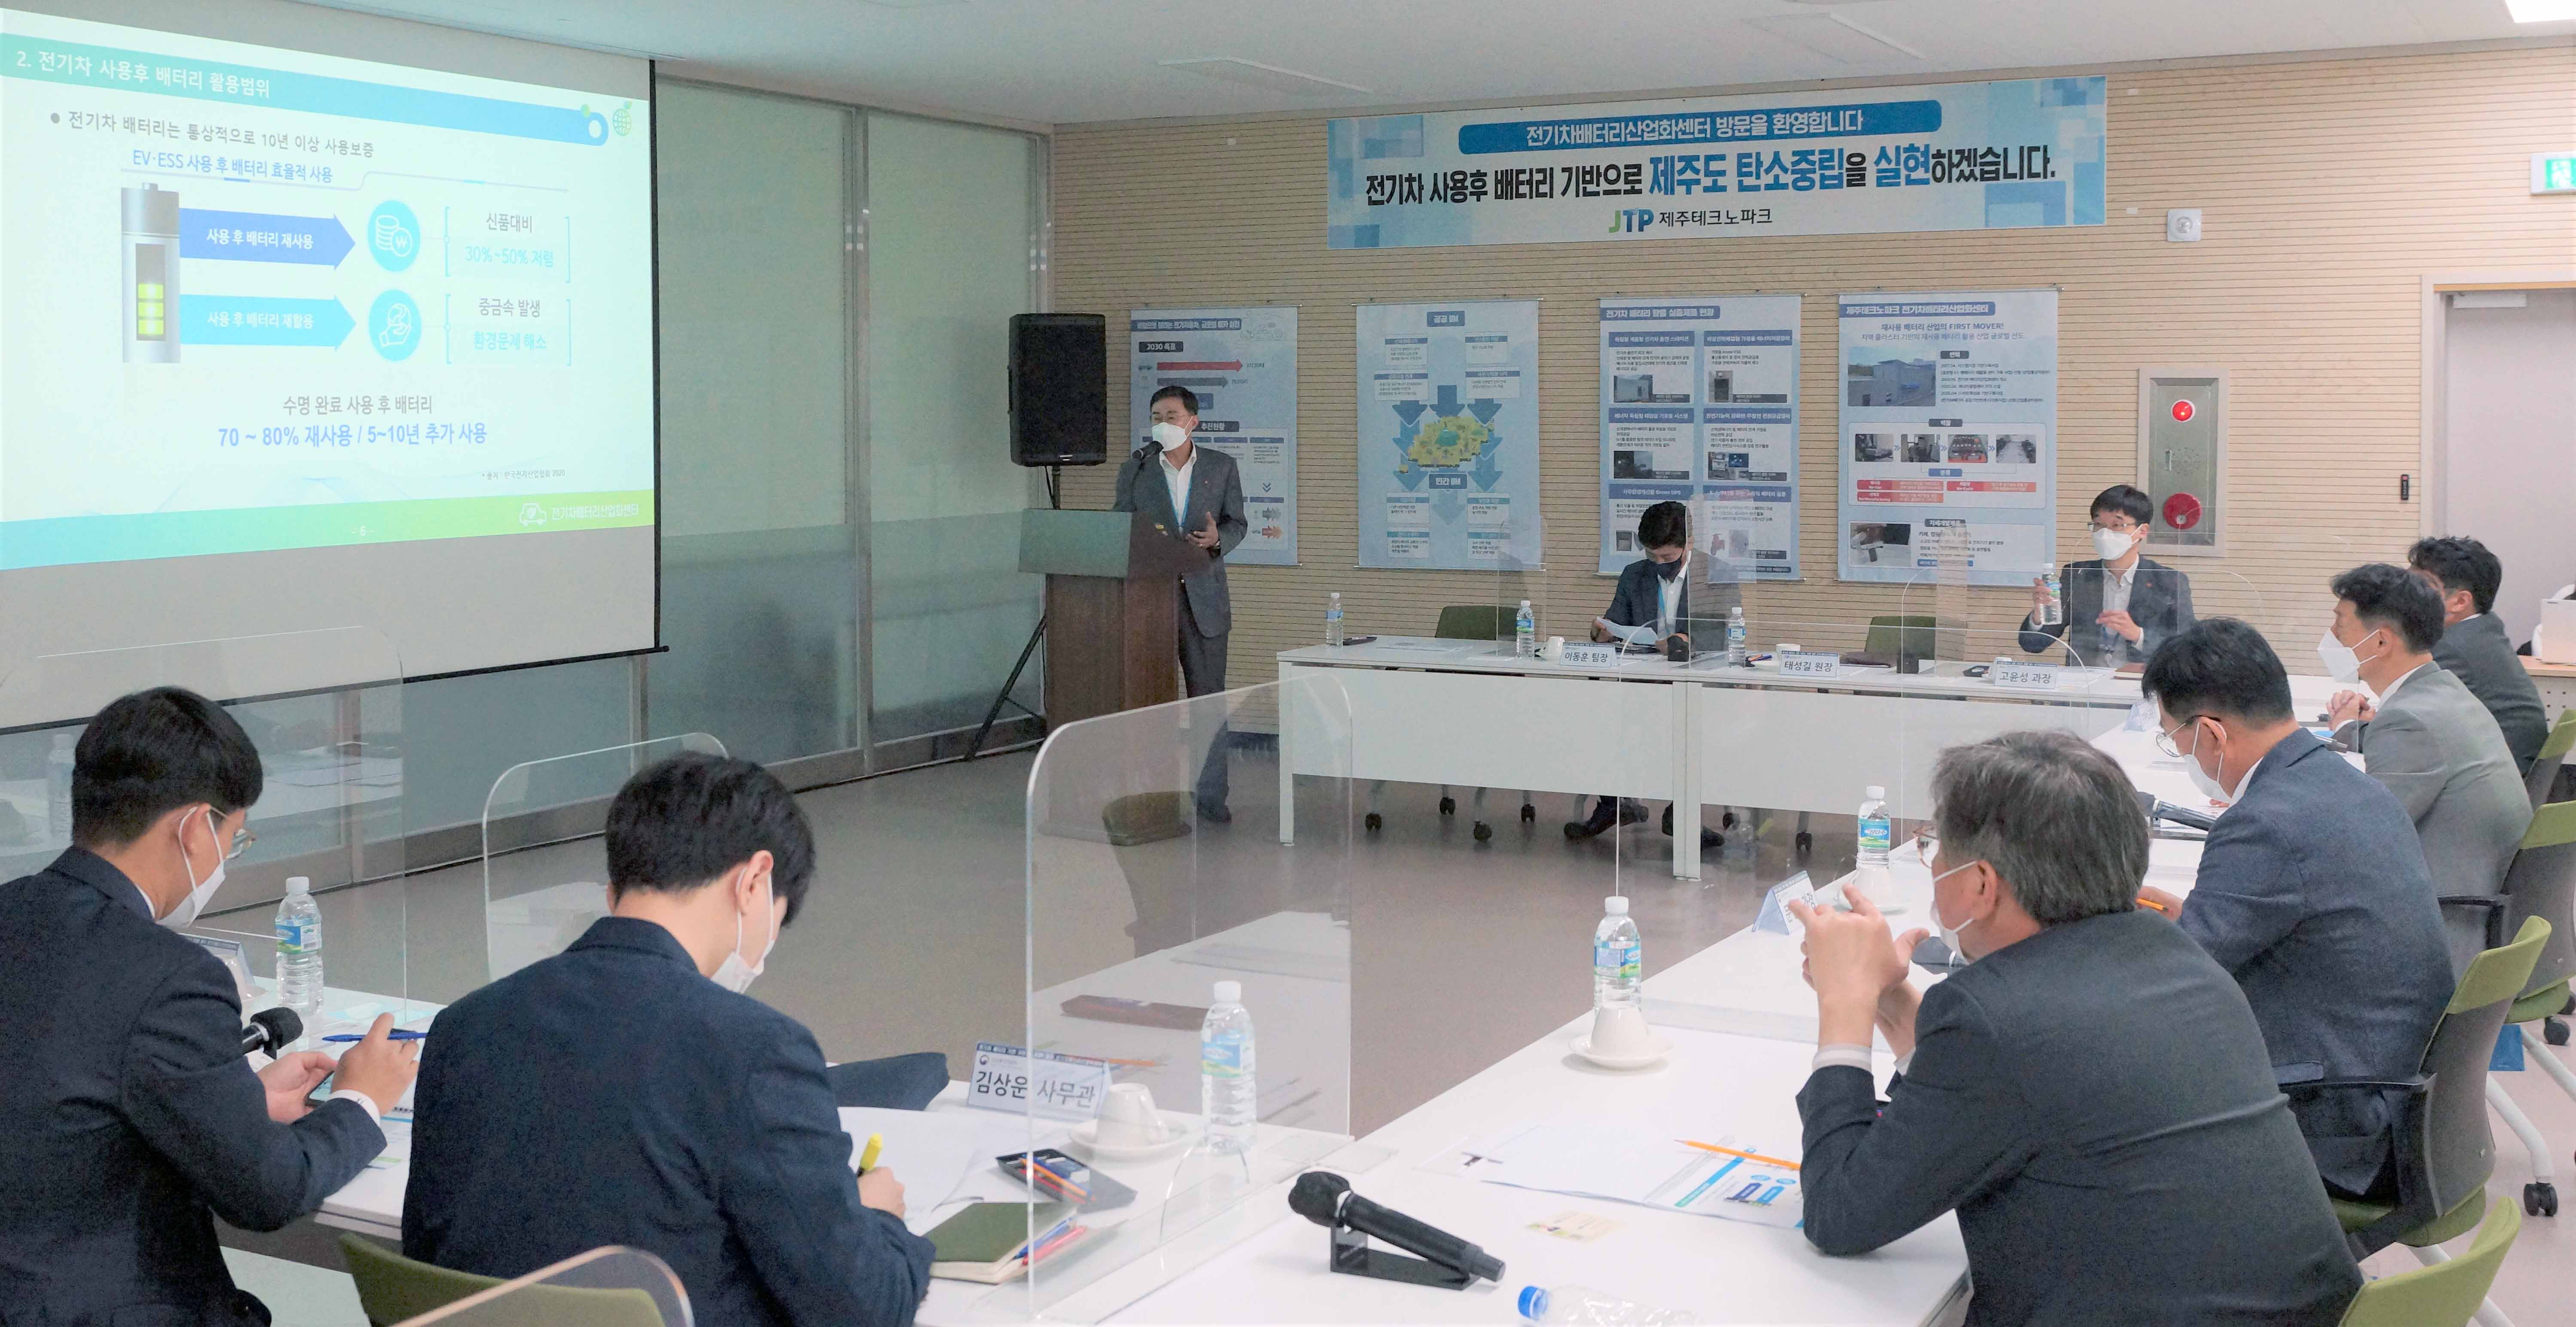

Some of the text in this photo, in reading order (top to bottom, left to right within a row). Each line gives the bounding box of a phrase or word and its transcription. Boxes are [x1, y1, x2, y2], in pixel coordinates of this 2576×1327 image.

[17, 51, 270, 98] 2. 전기차 사용후 배터리 활용범위
[69, 111, 374, 159] 전기차 배터리는 통상적으로 10년 이상 사용보증
[1526, 109, 1863, 146] 전기차배터리산업화센터 방문을 환영합니다
[187, 155, 213, 173] 사용
[216, 156, 228, 174] 후
[232, 158, 268, 178] 배터리
[272, 162, 307, 181] 효율적
[310, 165, 333, 183] 사용
[1366, 143, 2056, 206] 전기차 사용후 배터리 기반으로 제주도 탄소중립을 실현하겠습니다.
[486, 213, 532, 233] 신품대비
[1609, 207, 1654, 233] JTP
[1659, 209, 1772, 227] 제주테크노파크
[207, 229, 314, 250] 사용 후 배터리 재사용
[532, 249, 554, 268] 저렴
[479, 298, 541, 318] 중금속 발생
[1606, 310, 1628, 318] 전기차
[1846, 304, 1989, 314] 제주테크노파크 전기차배터리산업화센터
[207, 311, 314, 330] 사용 후 배터리 재활용
[1881, 323, 1902, 332] 재사용
[1927, 323, 1947, 331] 산업의
[474, 332, 547, 351] 환경문제 해소
[283, 394, 432, 416] 수명 완료 사용 후 배터리
[218, 429, 239, 447] 70
[263, 427, 300, 446] 80%
[304, 425, 353, 448] 재사용
[368, 425, 419, 446] 5~10년
[425, 423, 455, 445] 추가
[459, 423, 487, 444] 사용
[552, 469, 566, 478] 2020
[551, 503, 639, 520] 전기차배터리산업화센터
[1564, 652, 1608, 663] 이동훈 팀장
[1784, 660, 1834, 672] 태성길 원장
[1999, 671, 2052, 684] 고윤성 과장
[976, 1071, 1096, 1108] 김상운 사무관
